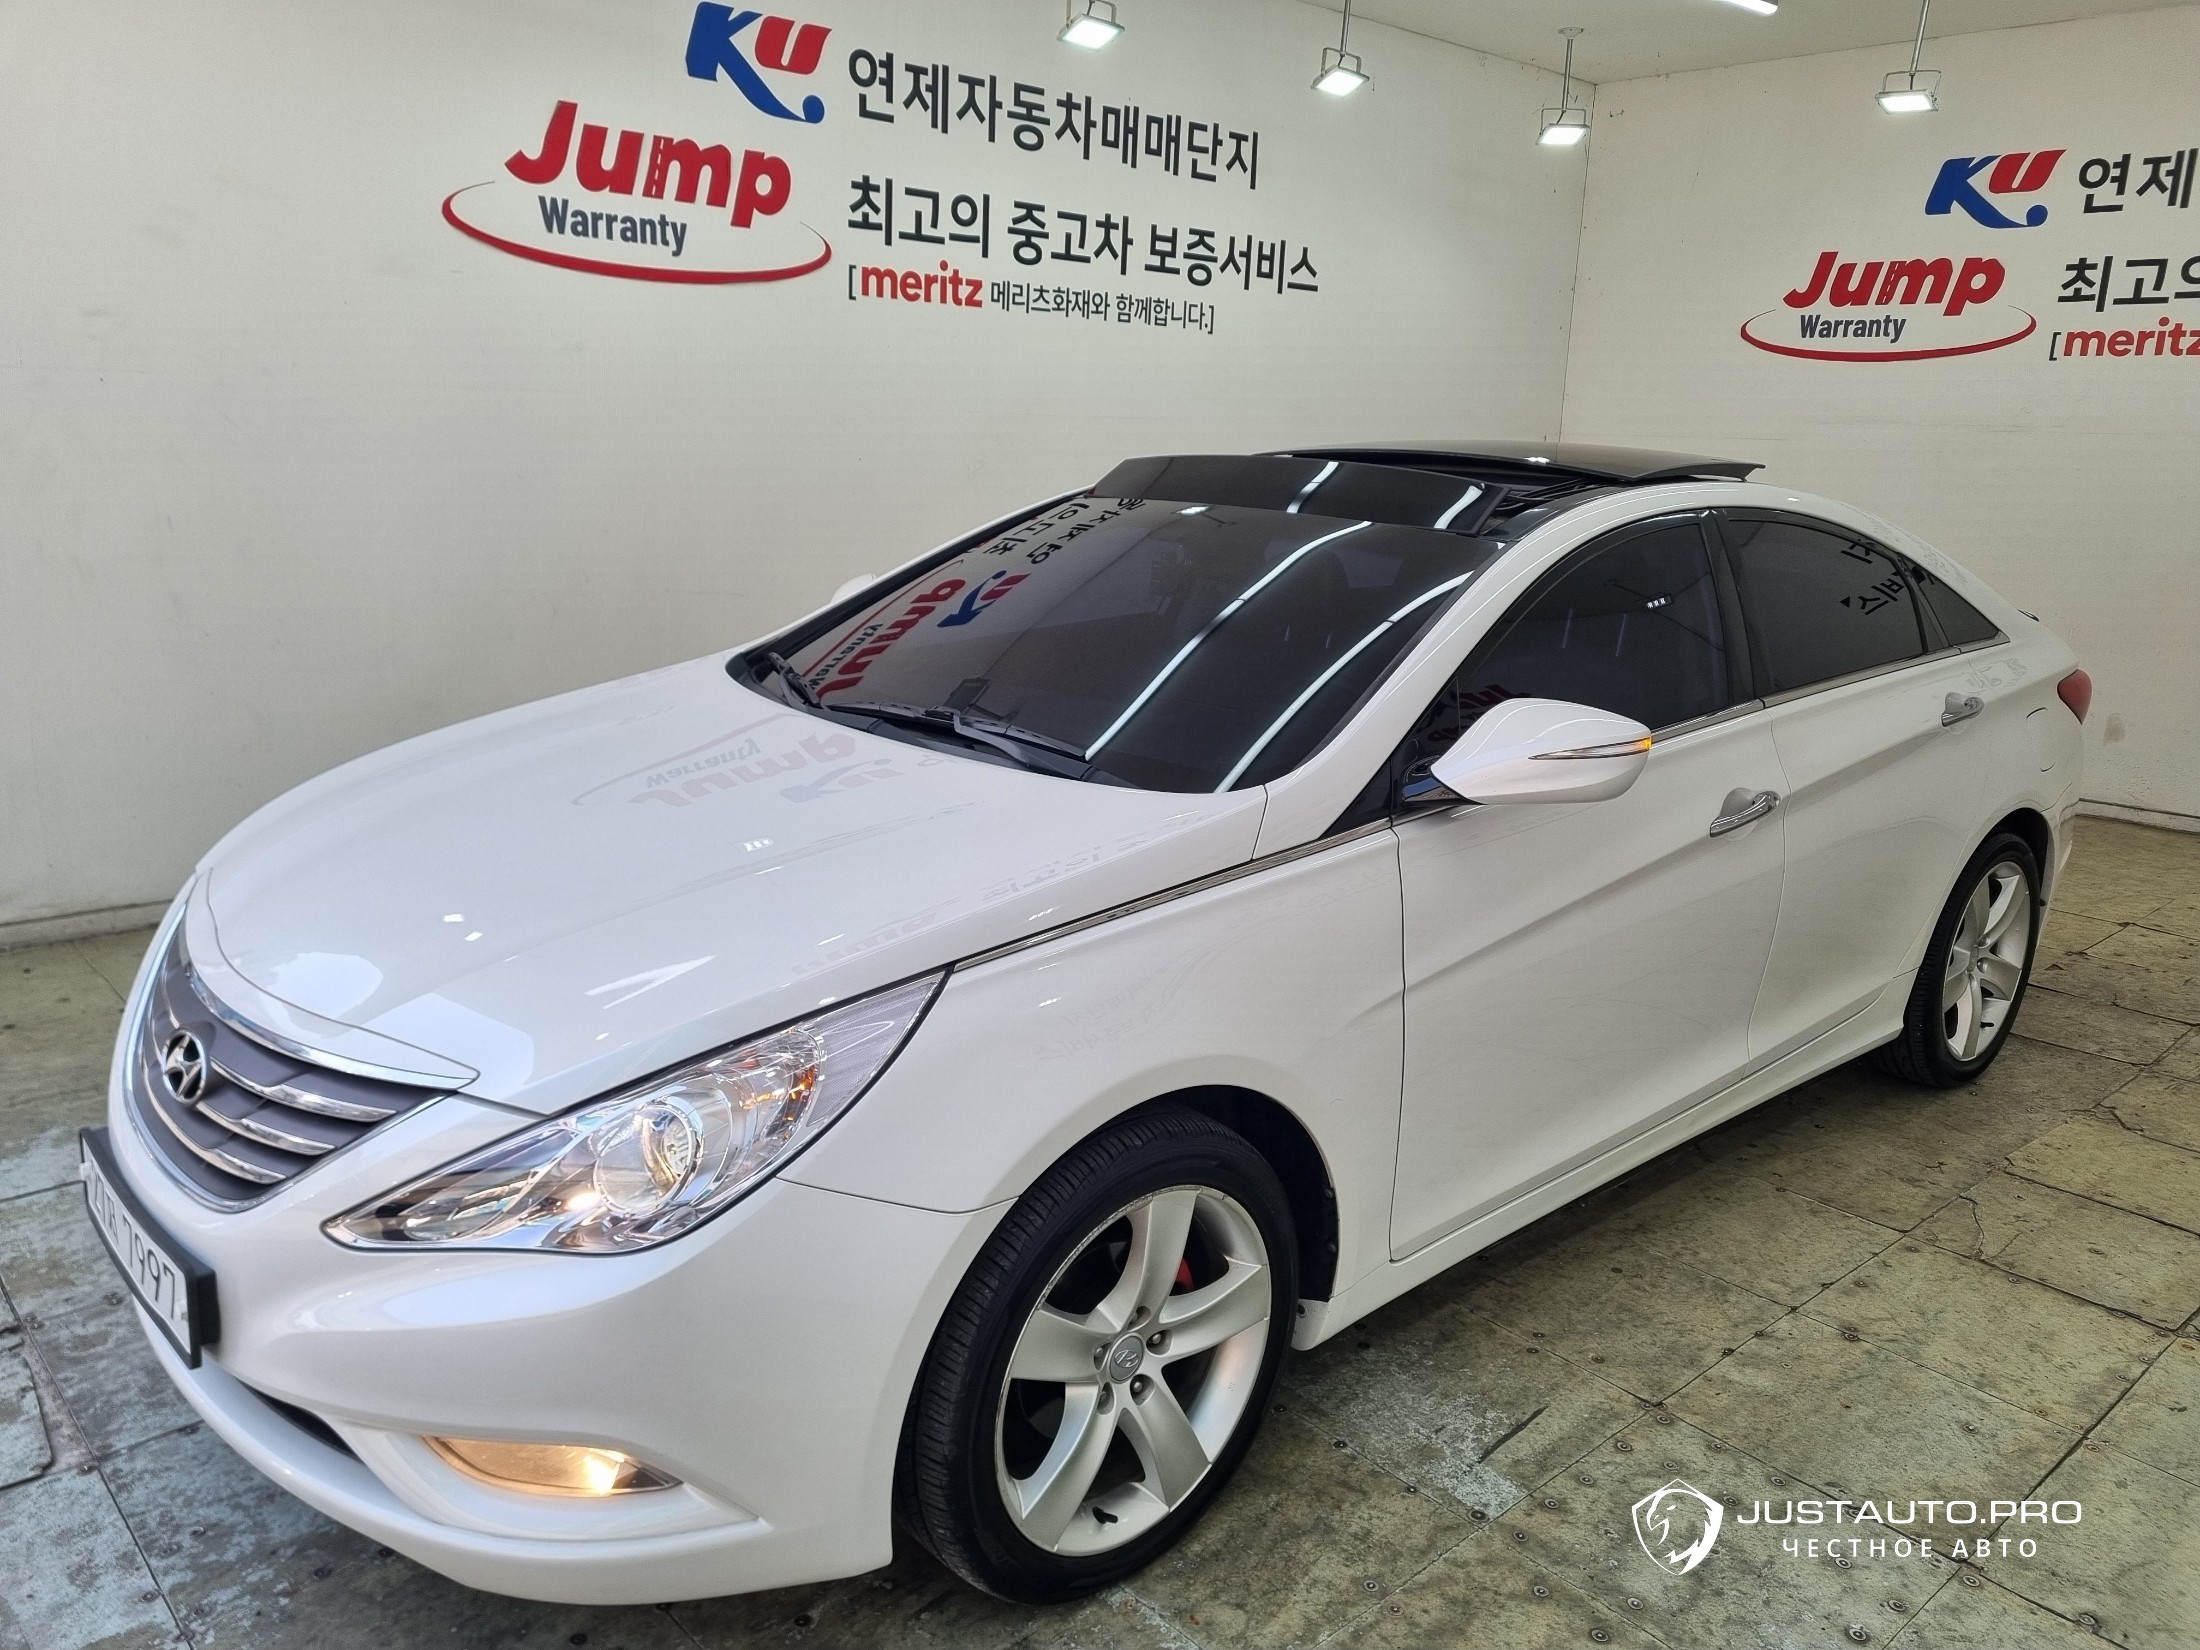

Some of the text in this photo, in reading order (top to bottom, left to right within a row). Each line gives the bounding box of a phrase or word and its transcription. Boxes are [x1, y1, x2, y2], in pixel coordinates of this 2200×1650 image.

[847, 48, 1260, 190] 연제자동차매매단지
[504, 100, 792, 229] Jump
[2078, 148, 2200, 213] 연제
[538, 195, 687, 257] Warranty
[848, 174, 1319, 295] 최고의 중고차 보증서비스
[991, 280, 1109, 321] 메리츠화재와
[1783, 251, 2006, 317] Jump
[1800, 314, 1906, 344] Warranty
[122, 1211, 176, 1320] 7997
